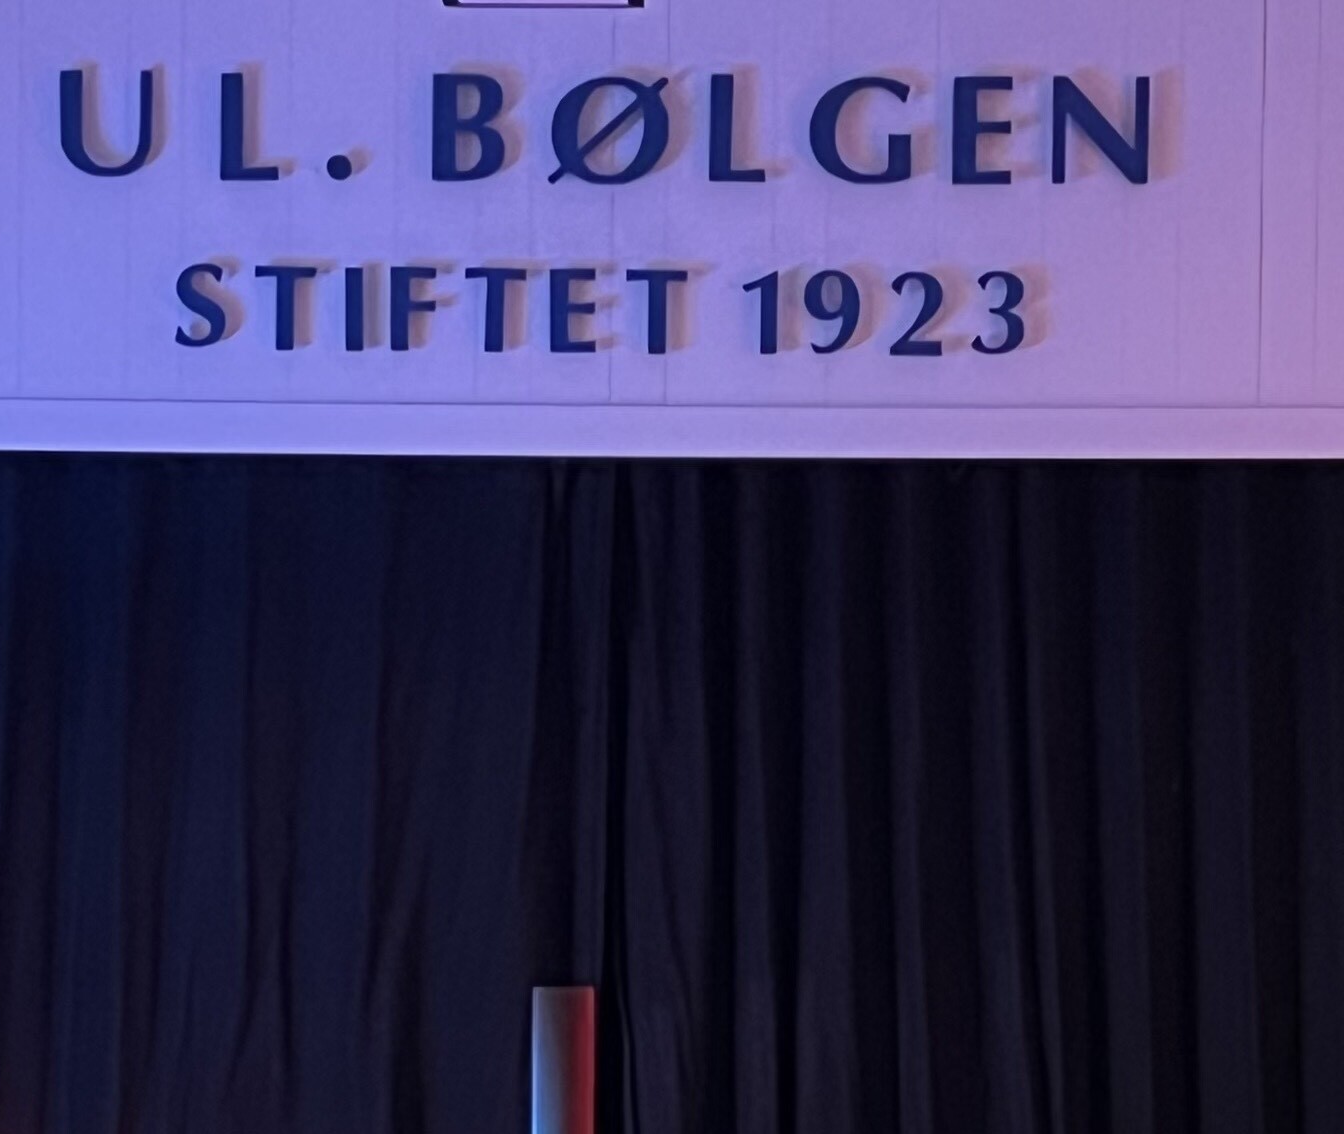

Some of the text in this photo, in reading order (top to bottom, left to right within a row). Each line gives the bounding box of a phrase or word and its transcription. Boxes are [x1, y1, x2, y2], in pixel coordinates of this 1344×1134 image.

[58, 68, 1151, 186] UL. BØLGEN
[174, 263, 1026, 357] STIFTET 1923
